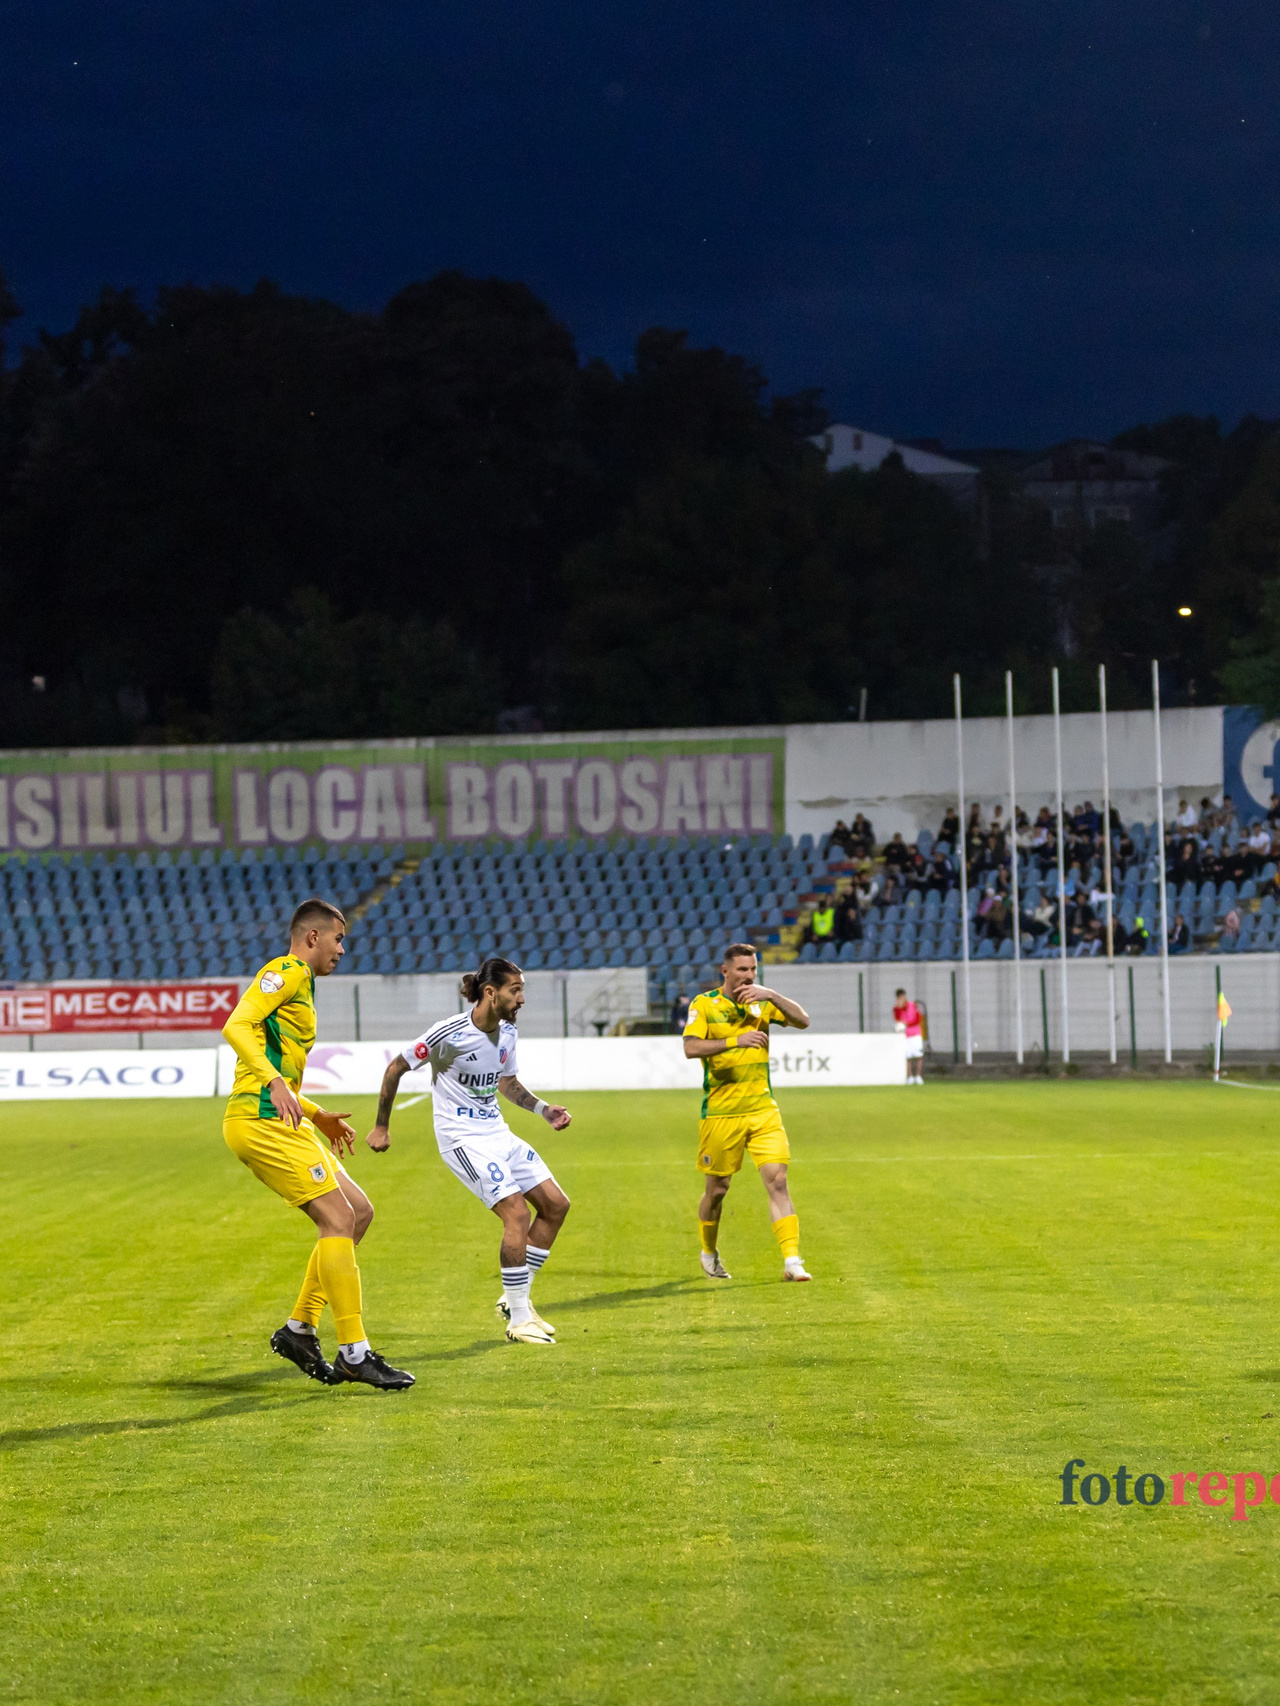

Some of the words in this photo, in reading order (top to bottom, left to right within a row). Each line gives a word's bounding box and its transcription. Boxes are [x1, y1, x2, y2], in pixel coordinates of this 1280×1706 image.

[0, 772, 222, 848] SILIUL
[236, 766, 435, 842] LOCAL
[450, 757, 769, 837] BOTOSANI
[53, 989, 232, 1014] MECANEX
[487, 1162, 505, 1183] 8
